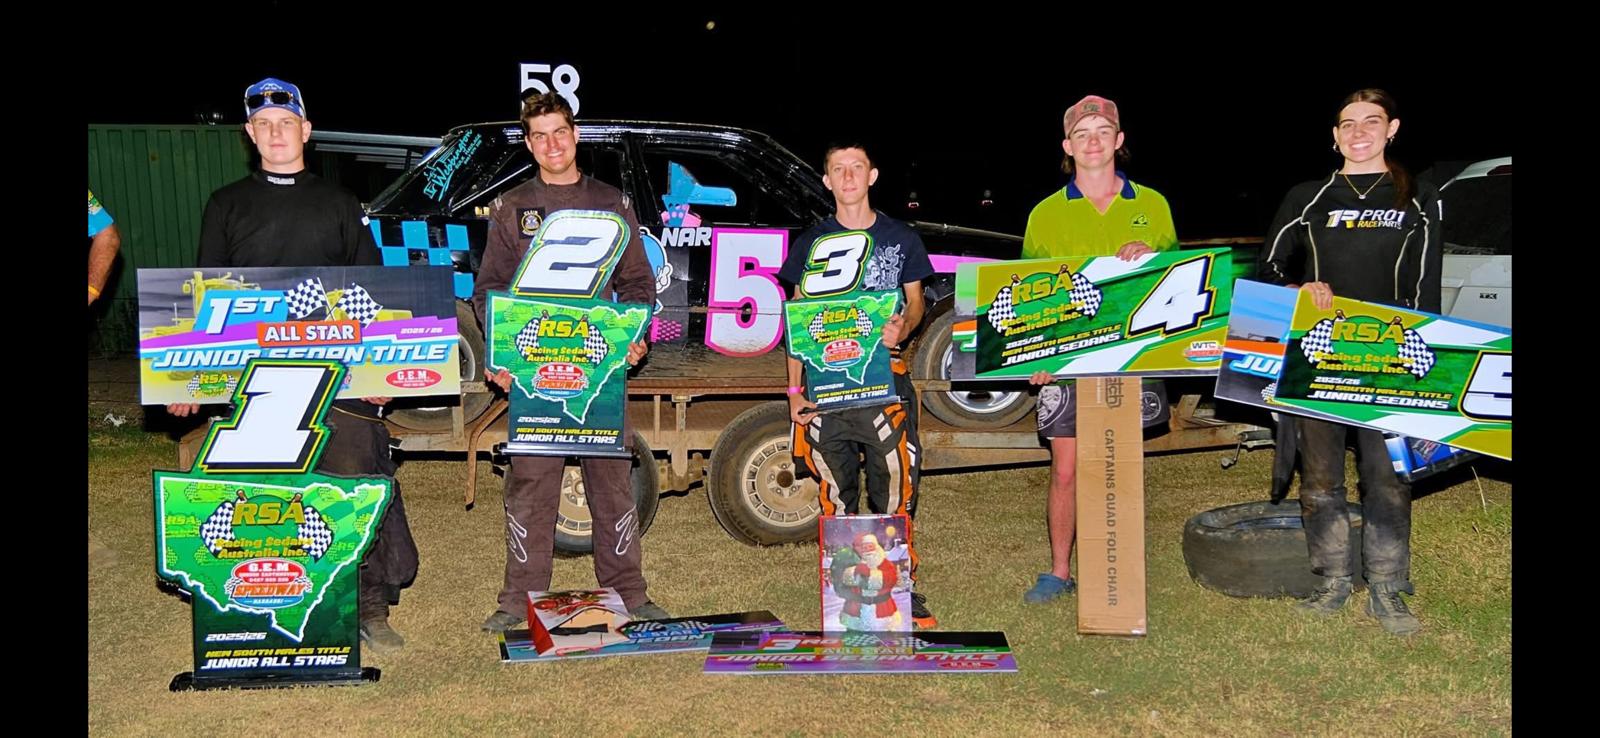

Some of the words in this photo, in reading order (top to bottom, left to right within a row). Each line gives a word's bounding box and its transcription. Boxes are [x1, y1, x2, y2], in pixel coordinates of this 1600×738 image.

[660, 227, 712, 247] NAR
[515, 215, 622, 292] 2
[803, 232, 870, 295] 3
[1011, 272, 1074, 305] RSA
[1129, 254, 1213, 335] 4
[205, 296, 282, 334] 1ST
[822, 307, 859, 323] RSA
[1000, 312, 1041, 327] Racing
[1042, 301, 1086, 316] Sedans
[1005, 317, 1058, 336] Australia
[1060, 311, 1082, 321] Inc.
[264, 326, 302, 343] ALL
[306, 324, 355, 341] STAR
[537, 320, 590, 338] RSA
[1330, 321, 1405, 344] RSA
[1001, 346, 1056, 366] JUNIOR
[1058, 332, 1121, 353] SEDANS
[1002, 347, 1022, 357] NEW
[1023, 339, 1057, 352] SOUTH
[1057, 332, 1091, 344] WALES
[1092, 324, 1122, 336] TITLE
[1005, 335, 1044, 349] 2025/26
[153, 350, 261, 368] JUNIOR
[373, 344, 448, 361] TITLE
[525, 346, 558, 355] Racing
[560, 346, 595, 355] Sedans
[527, 354, 570, 362] Australia
[572, 354, 589, 362] Inc.
[1313, 351, 1362, 362] Racing
[1364, 353, 1415, 364] Sedans
[1316, 361, 1379, 373] Australia
[1382, 364, 1408, 374] Inc.
[200, 373, 228, 384] RSA
[1314, 376, 1361, 385] 2025/26
[815, 396, 843, 405] JUNIOR
[860, 389, 888, 398] STARS
[1307, 390, 1373, 403] JUNIOR
[1374, 395, 1450, 409] SEDANS
[1309, 382, 1334, 390] NEW
[1335, 384, 1375, 393] SOUTH
[1376, 387, 1415, 397] WALES
[1417, 391, 1453, 399] TITLE
[205, 365, 330, 470] 1
[512, 434, 553, 442] JUNIOR
[554, 435, 576, 443] ALL
[577, 436, 617, 444] STARS
[535, 427, 564, 435] SOUTH
[565, 428, 593, 436] WALES
[1104, 429, 1115, 489] CAPTAINS
[231, 502, 306, 525] RSA
[1105, 492, 1116, 527] QUAD
[215, 537, 263, 550] Racing
[266, 535, 313, 547] Sedans
[1106, 533, 1117, 566] FOLD
[218, 547, 280, 558] Australia
[282, 547, 307, 557] Inc.
[1107, 567, 1117, 607] CHAIR
[205, 650, 231, 658] NEW
[232, 648, 274, 657] SOUTH
[275, 647, 315, 655] WALES
[316, 646, 352, 654] TITLE
[926, 653, 1001, 661] TITLE
[201, 657, 260, 670] JUNIOR
[260, 656, 291, 667] ALL
[293, 654, 349, 666] STARS
